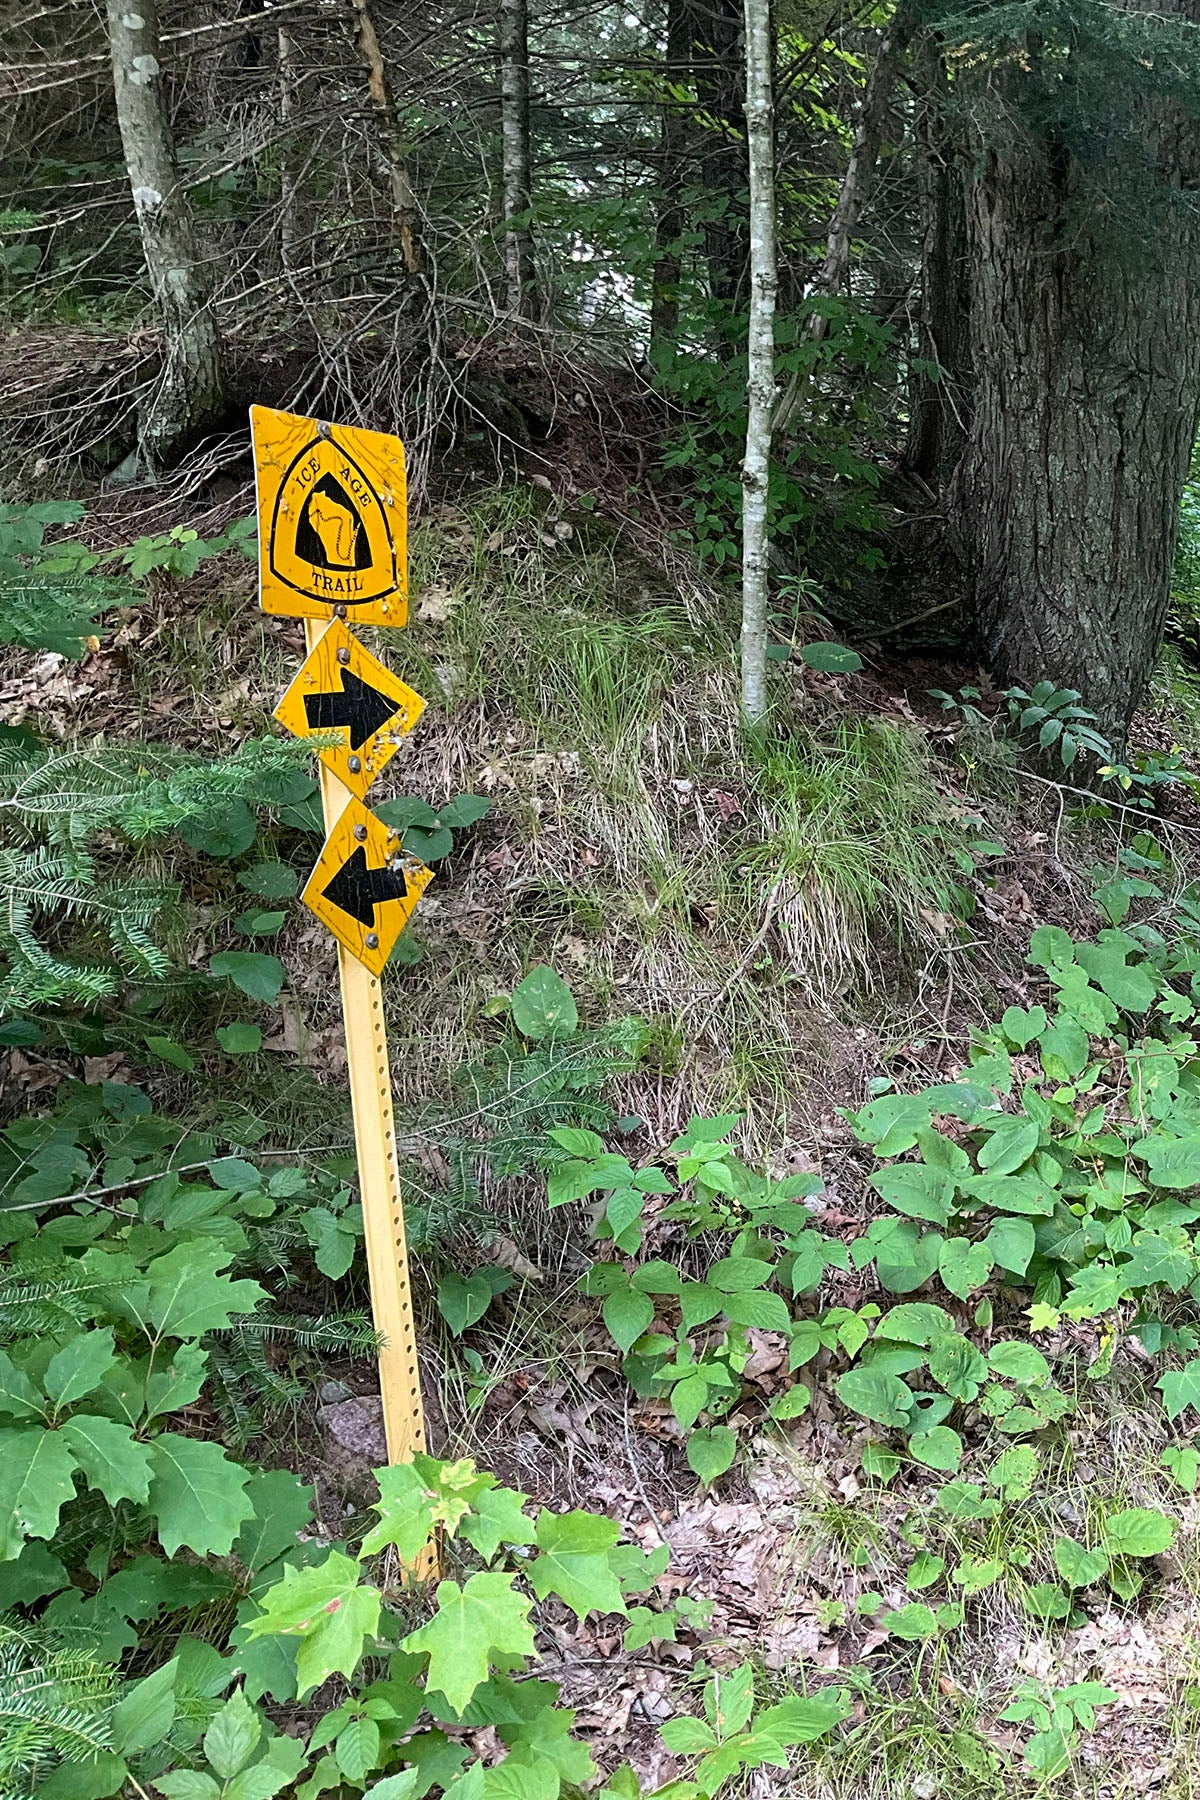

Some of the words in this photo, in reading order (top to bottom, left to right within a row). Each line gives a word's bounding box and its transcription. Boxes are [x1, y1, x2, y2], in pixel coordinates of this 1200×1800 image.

[295, 457, 321, 490] ICE
[339, 467, 372, 507] AGE
[311, 572, 363, 592] TRAIL
